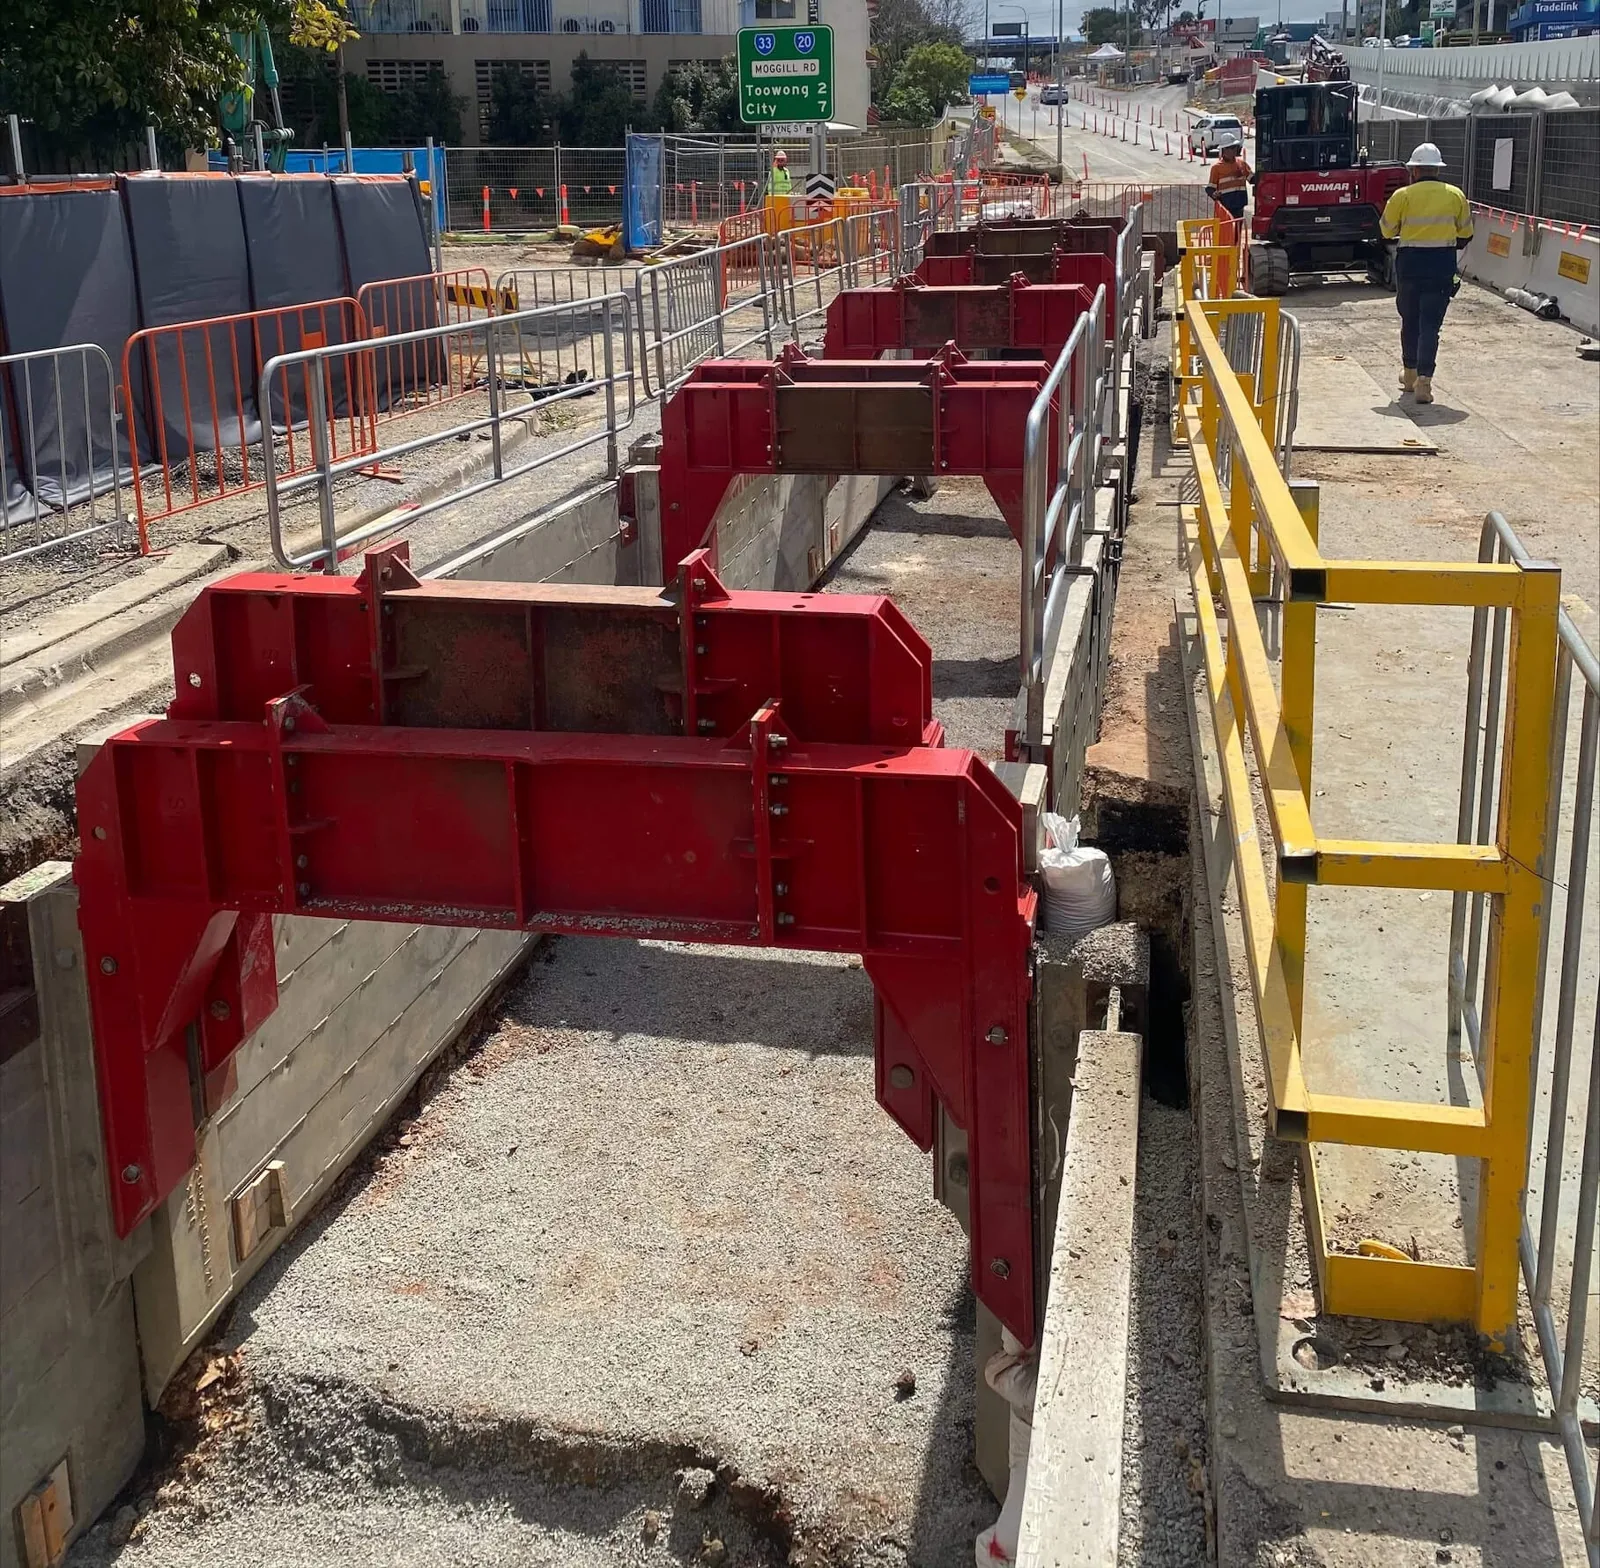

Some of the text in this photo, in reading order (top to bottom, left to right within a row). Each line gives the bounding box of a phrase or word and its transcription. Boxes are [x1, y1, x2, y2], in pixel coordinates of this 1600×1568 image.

[1535, 2, 1578, 12] Tradelink
[758, 37, 771, 49] 33
[798, 35, 811, 48] 20
[755, 62, 817, 74] MOGGILL RD
[745, 82, 827, 97] Toowong 2
[746, 101, 827, 117] City 7
[765, 124, 802, 133] PAYNE ST
[1301, 182, 1350, 192] YANMAR
